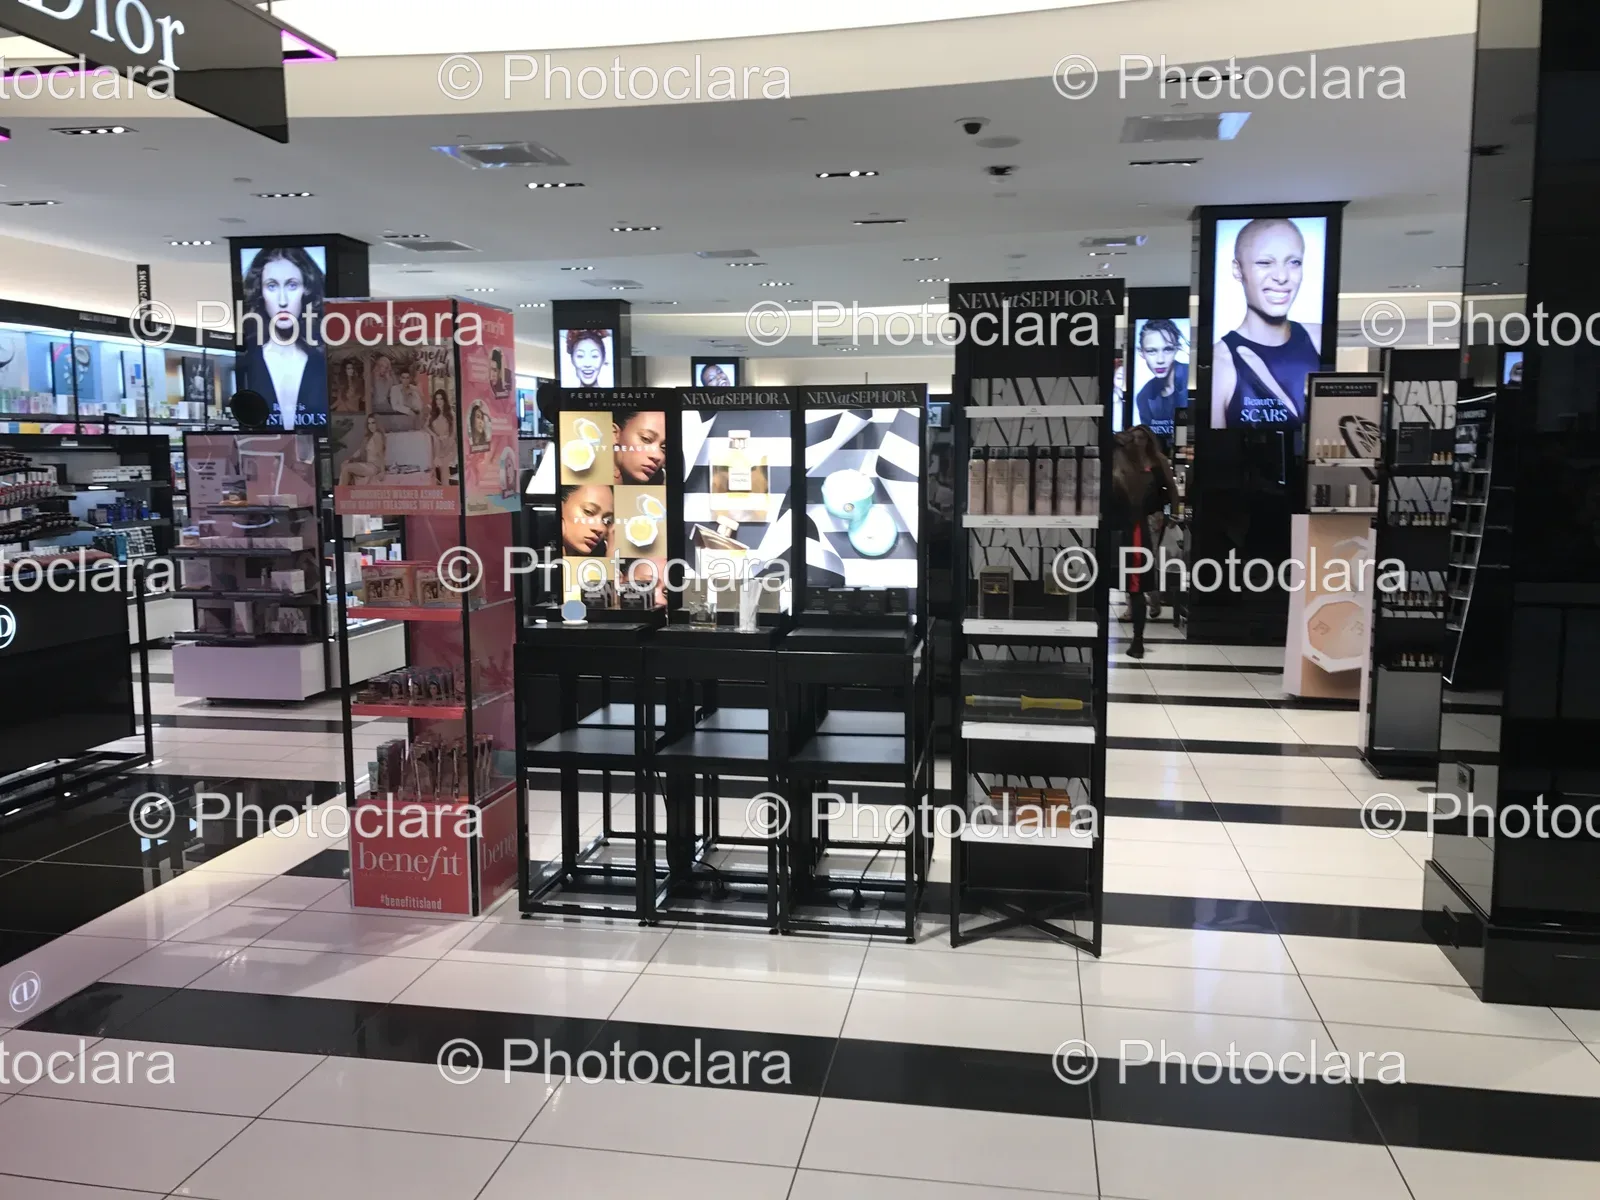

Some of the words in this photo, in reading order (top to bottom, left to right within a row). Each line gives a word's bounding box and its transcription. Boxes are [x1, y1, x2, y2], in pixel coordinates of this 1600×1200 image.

[1243, 396, 1275, 408] Beauty
[1240, 408, 1288, 422] SCARS
[357, 842, 463, 882] benefit
[380, 893, 443, 911] #benefitisland
